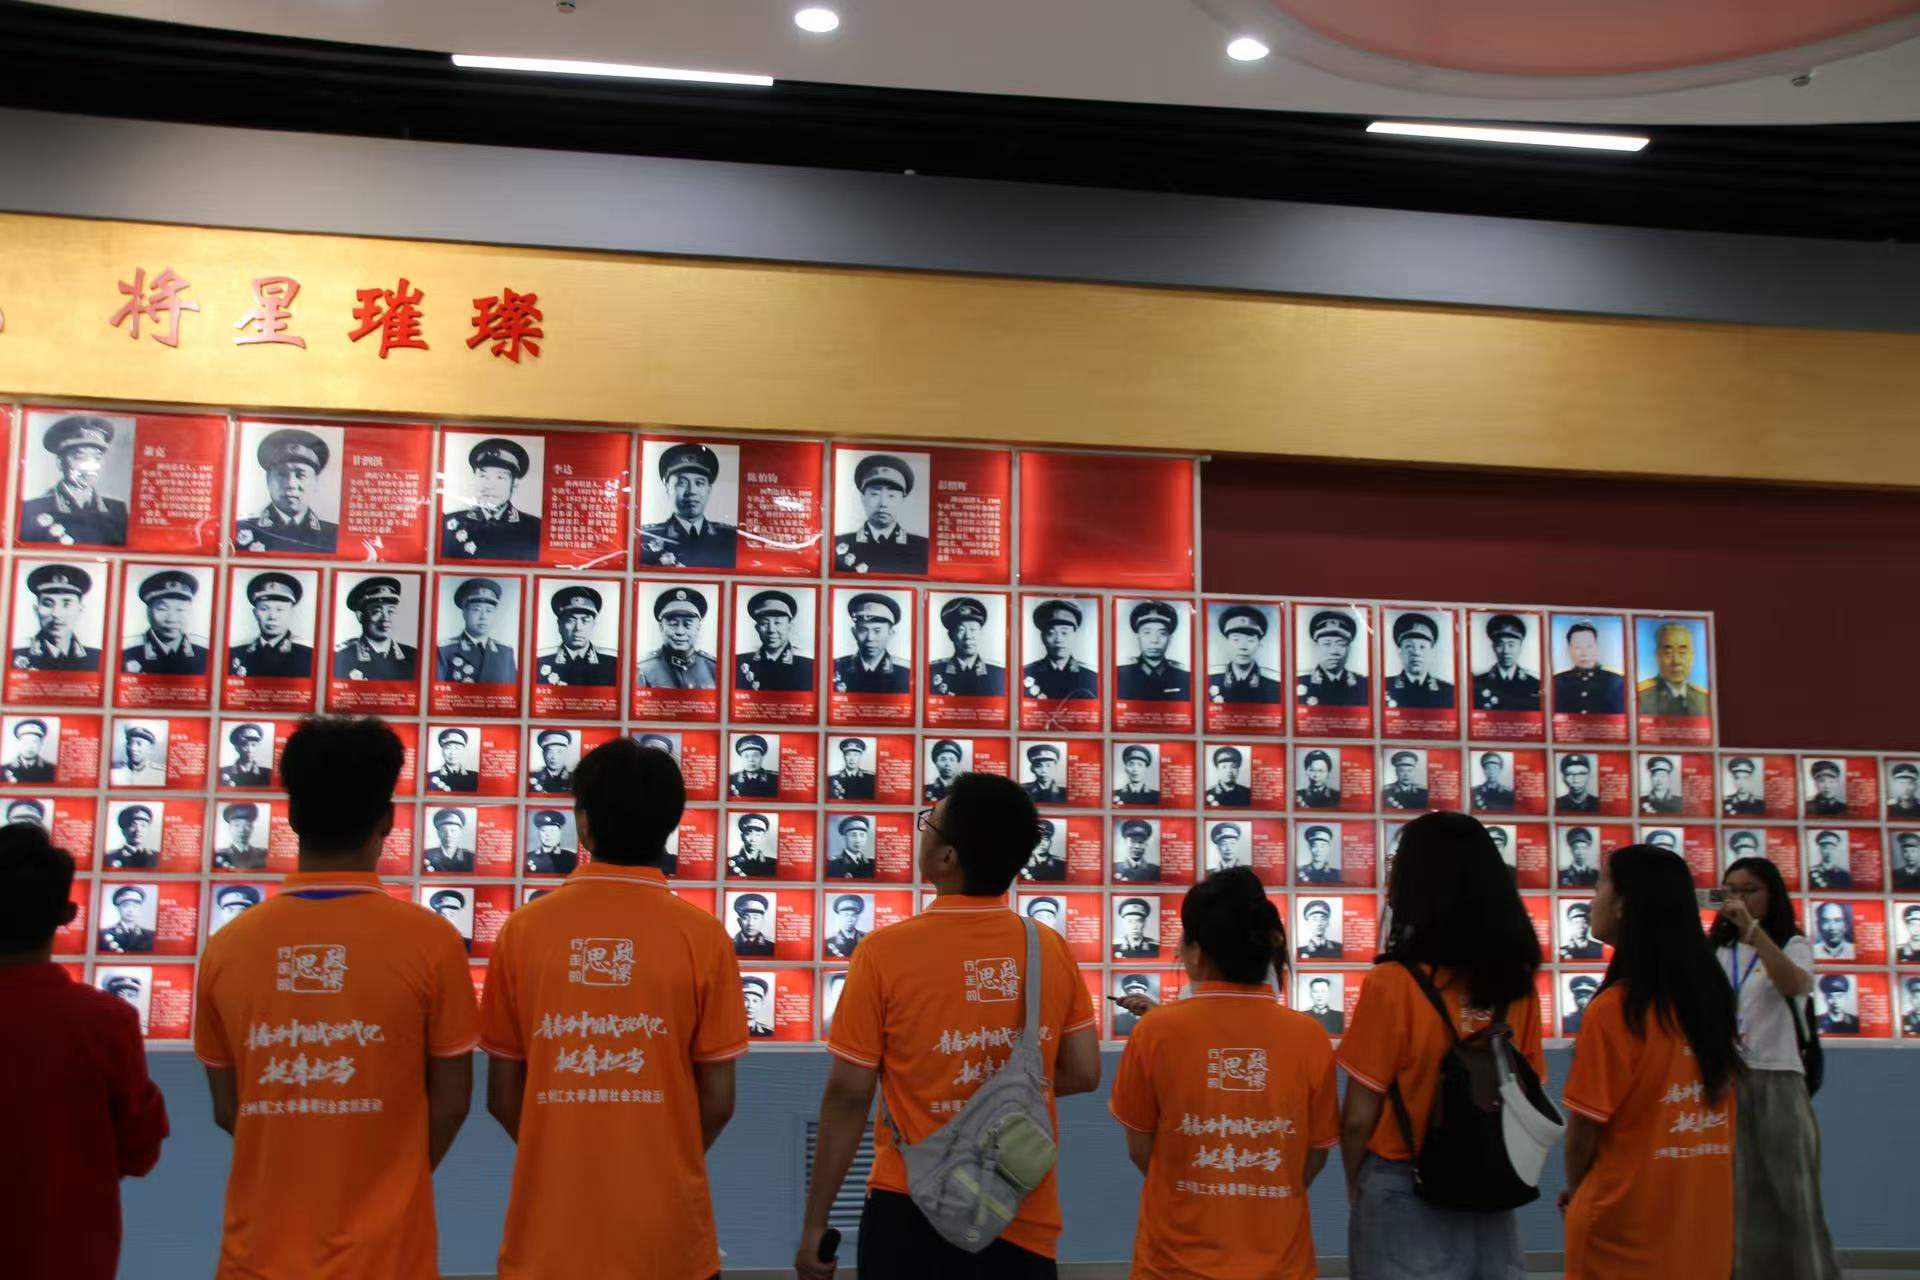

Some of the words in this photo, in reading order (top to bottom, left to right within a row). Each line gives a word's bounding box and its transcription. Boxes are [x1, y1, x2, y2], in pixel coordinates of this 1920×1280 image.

[109, 267, 545, 364] 将星璀璨
[963, 960, 978, 1001] 行走的
[932, 1026, 1053, 1055] 青春为中国式化
